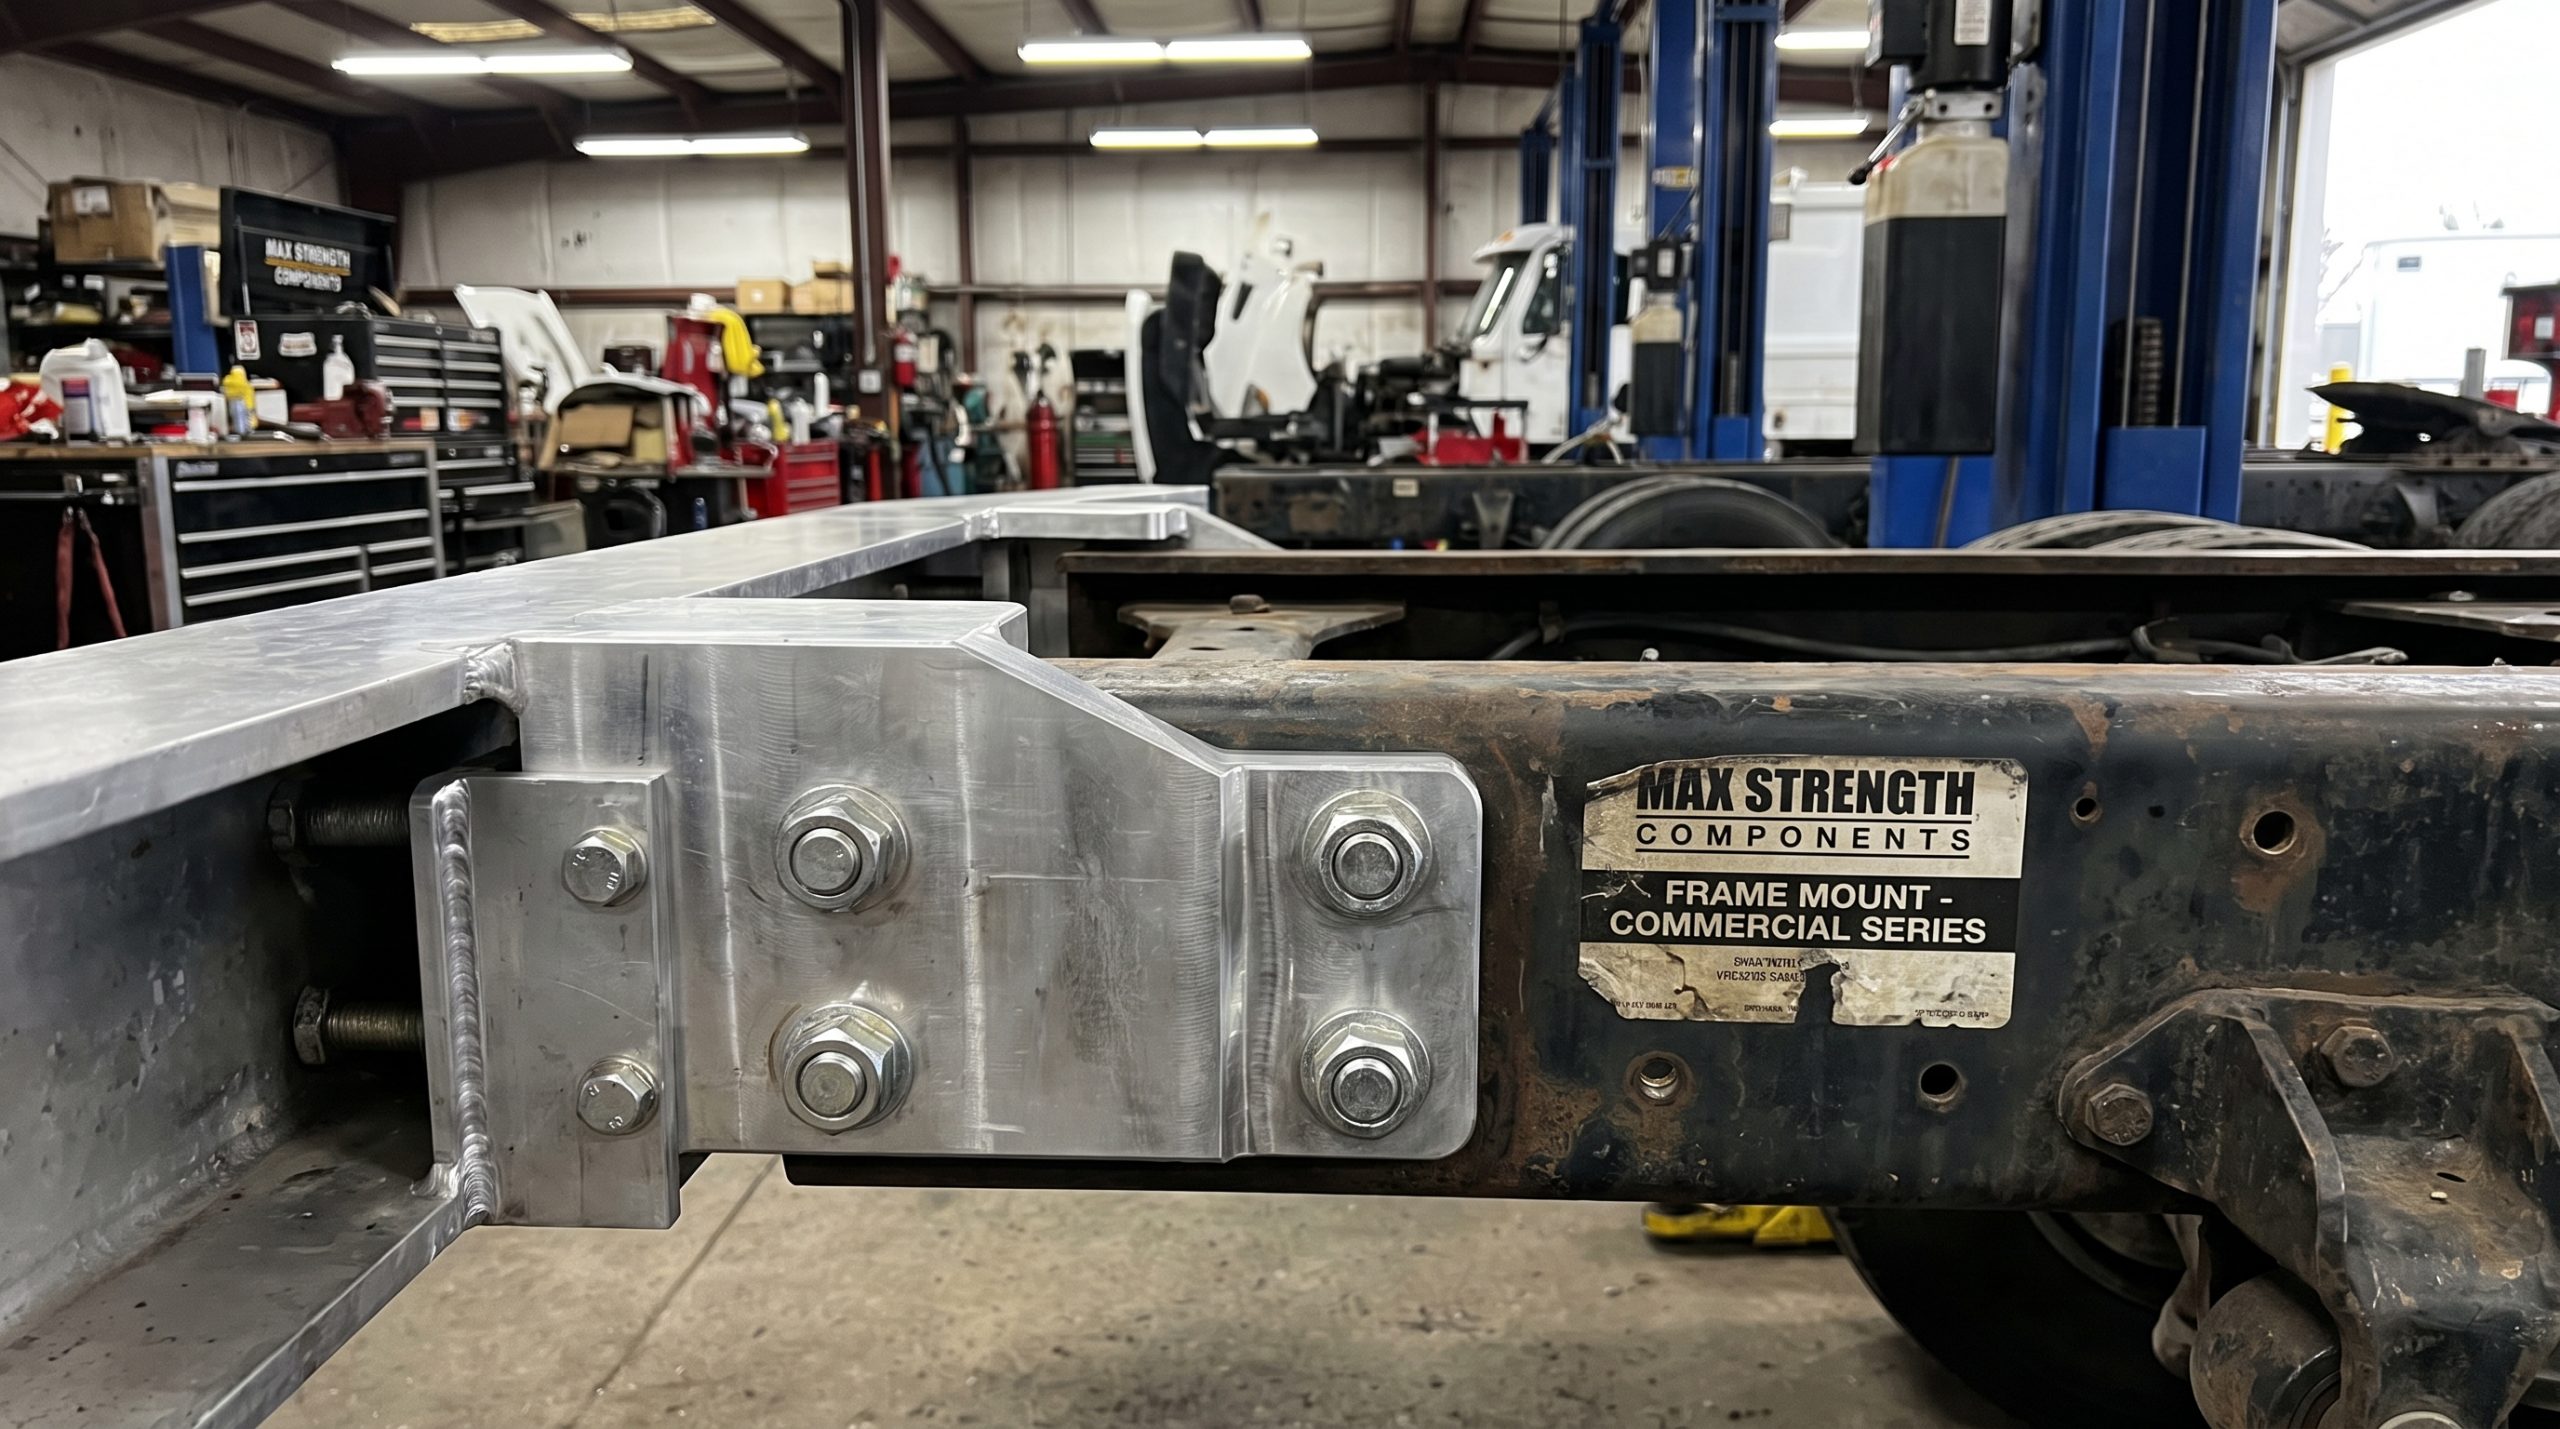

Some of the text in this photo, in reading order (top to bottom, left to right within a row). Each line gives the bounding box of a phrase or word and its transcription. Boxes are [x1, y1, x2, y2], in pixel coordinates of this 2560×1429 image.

[265, 238, 351, 268] MAX STRENGTH
[1637, 767, 1975, 815] MAX STRENGTH
[1636, 823, 1970, 851] COMPONENTS
[1666, 880, 1788, 907] FRAME
[1799, 883, 1931, 910] MOUNT
[1610, 912, 1986, 944] COMMERCIAL SERIES
